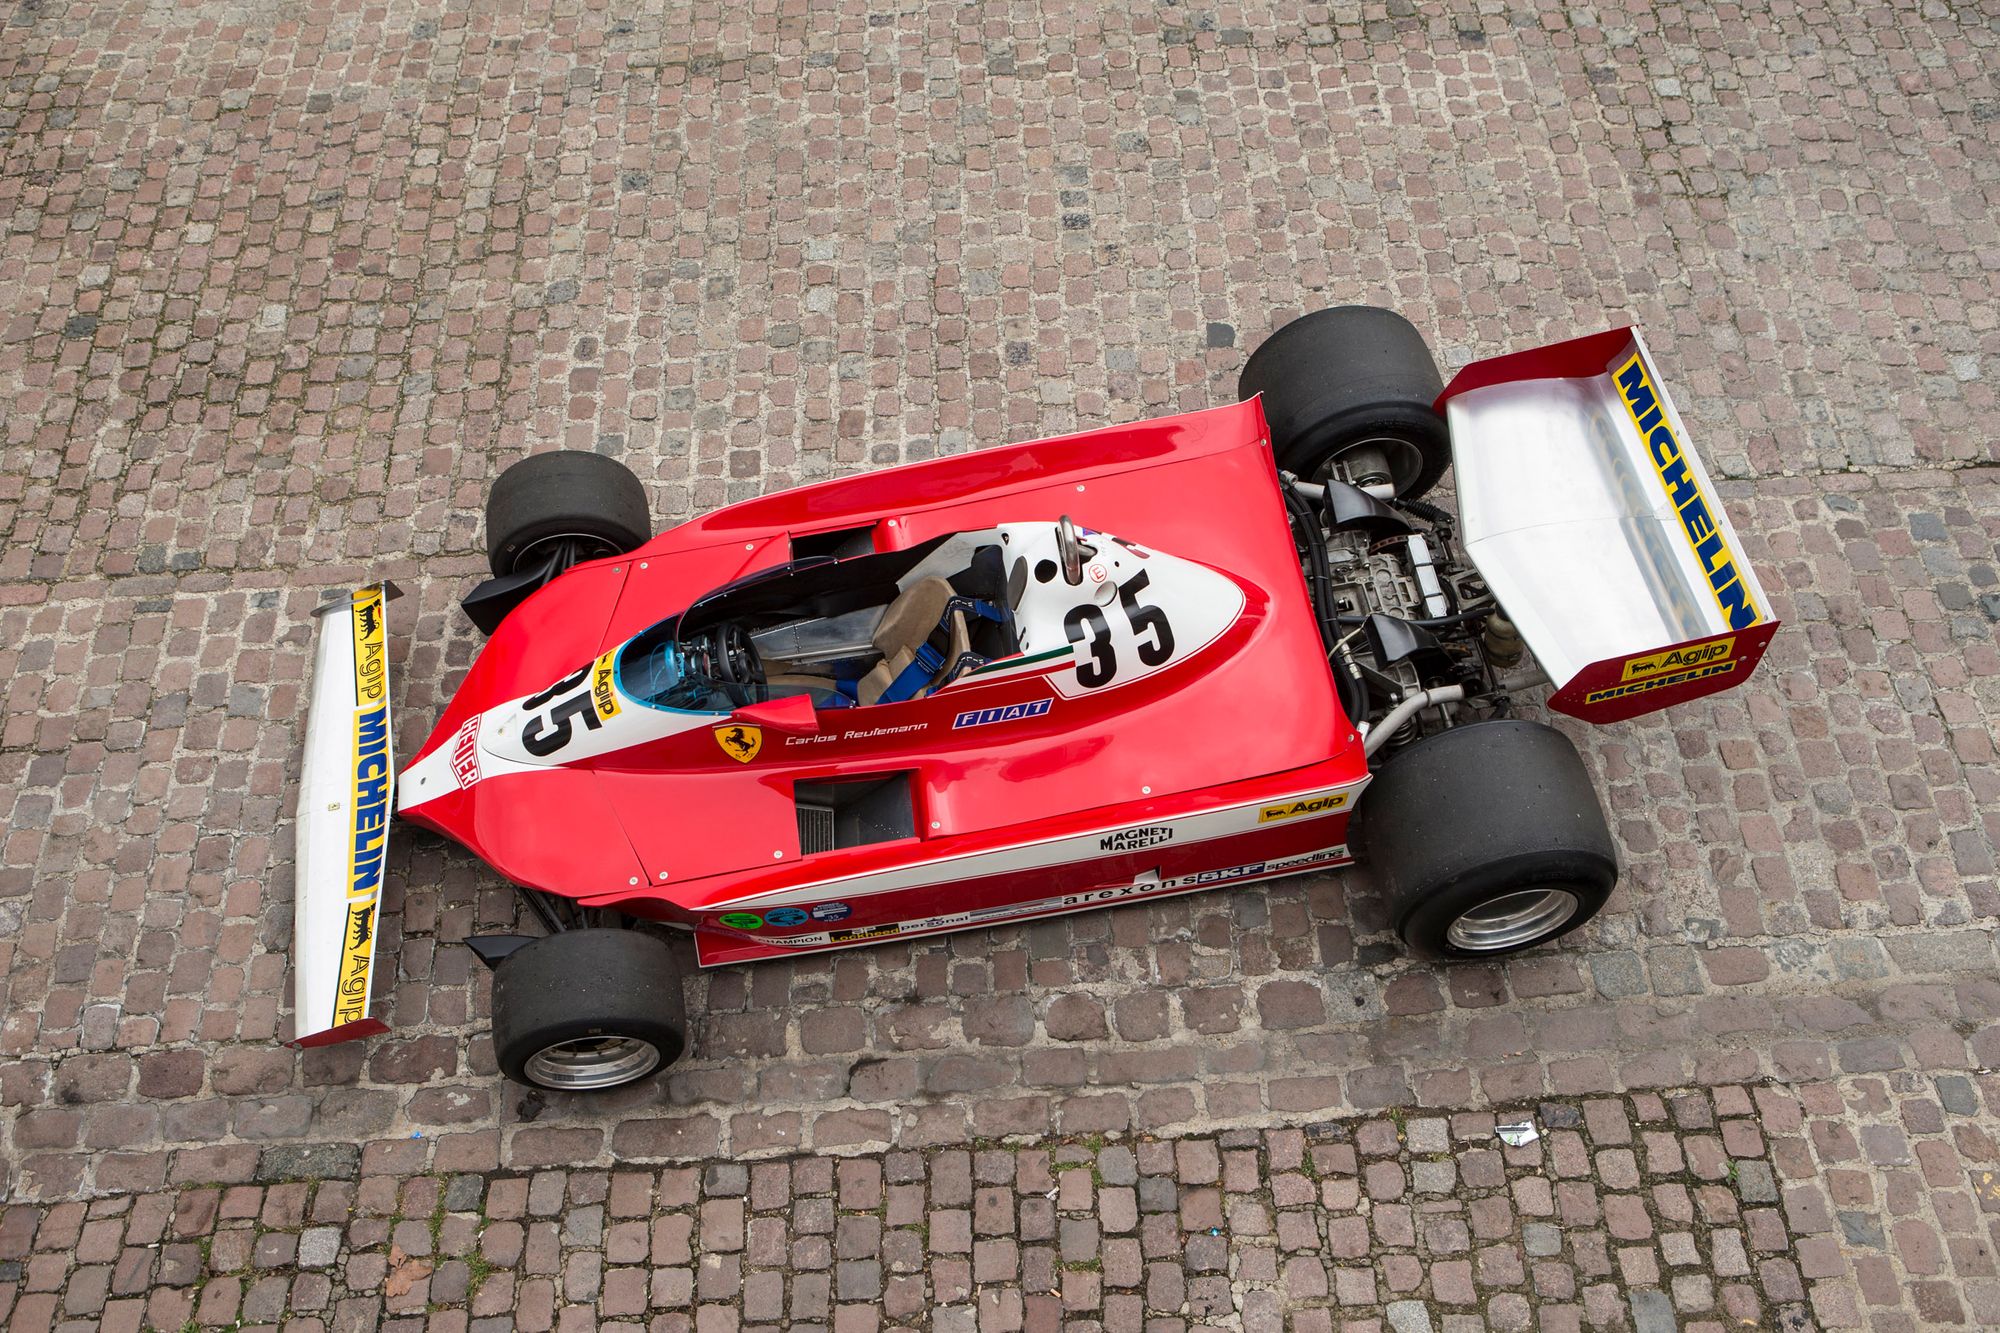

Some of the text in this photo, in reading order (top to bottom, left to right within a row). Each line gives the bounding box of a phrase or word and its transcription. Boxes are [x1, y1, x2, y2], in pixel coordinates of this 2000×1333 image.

[1618, 361, 1757, 631] MICHELIN
[1093, 567, 1104, 580] E
[1063, 568, 1176, 688] 35
[1659, 644, 1728, 669] Agip
[359, 641, 383, 699] Agip
[1588, 662, 1734, 702] MICHELIN
[594, 668, 614, 715] Agip
[961, 701, 1049, 726] FIAT
[454, 719, 479, 785] HEUER
[785, 734, 837, 746] Carlos
[353, 706, 387, 892] MICHELIN
[1289, 797, 1344, 814] Agip
[1100, 827, 1174, 847] MAGNETI
[1100, 831, 1174, 851] MARELLI
[1199, 863, 1264, 882] SKF
[1266, 850, 1344, 871] speedline
[1063, 875, 1197, 905] arexons
[831, 927, 900, 943] Lockheed
[901, 916, 969, 932] personal
[339, 954, 370, 1024] Agip
